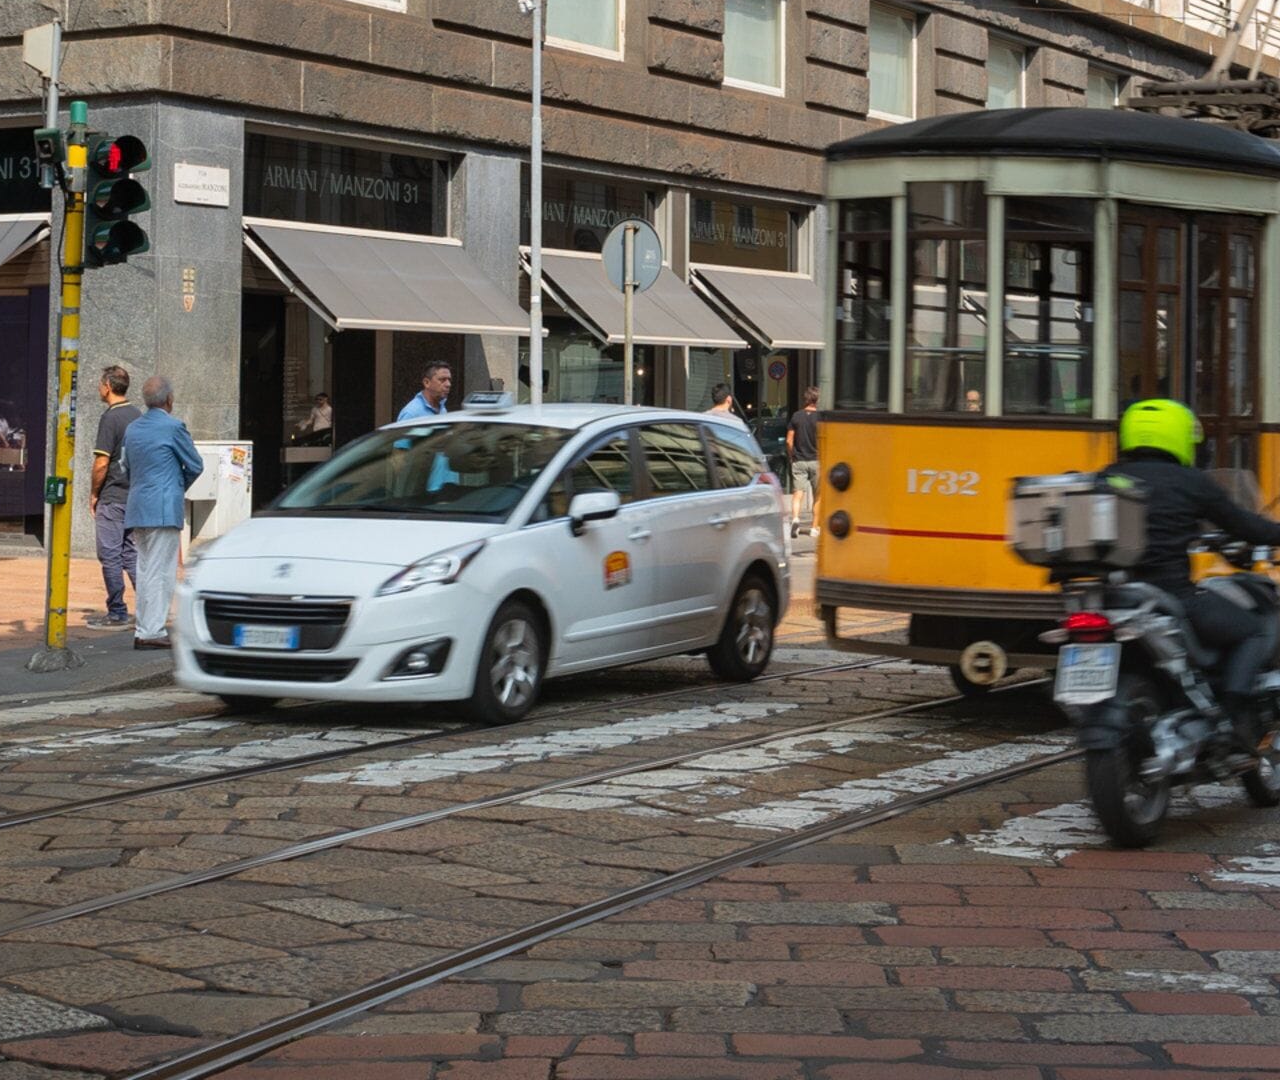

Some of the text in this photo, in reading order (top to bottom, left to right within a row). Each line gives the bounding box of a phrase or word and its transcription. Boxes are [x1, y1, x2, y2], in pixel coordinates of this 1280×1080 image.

[18, 156, 40, 179] 31
[263, 165, 317, 192] ARMANI
[330, 172, 399, 202] MANZONI
[402, 182, 418, 204] 31
[732, 225, 777, 248] MANZONI
[906, 468, 981, 497] 1732
